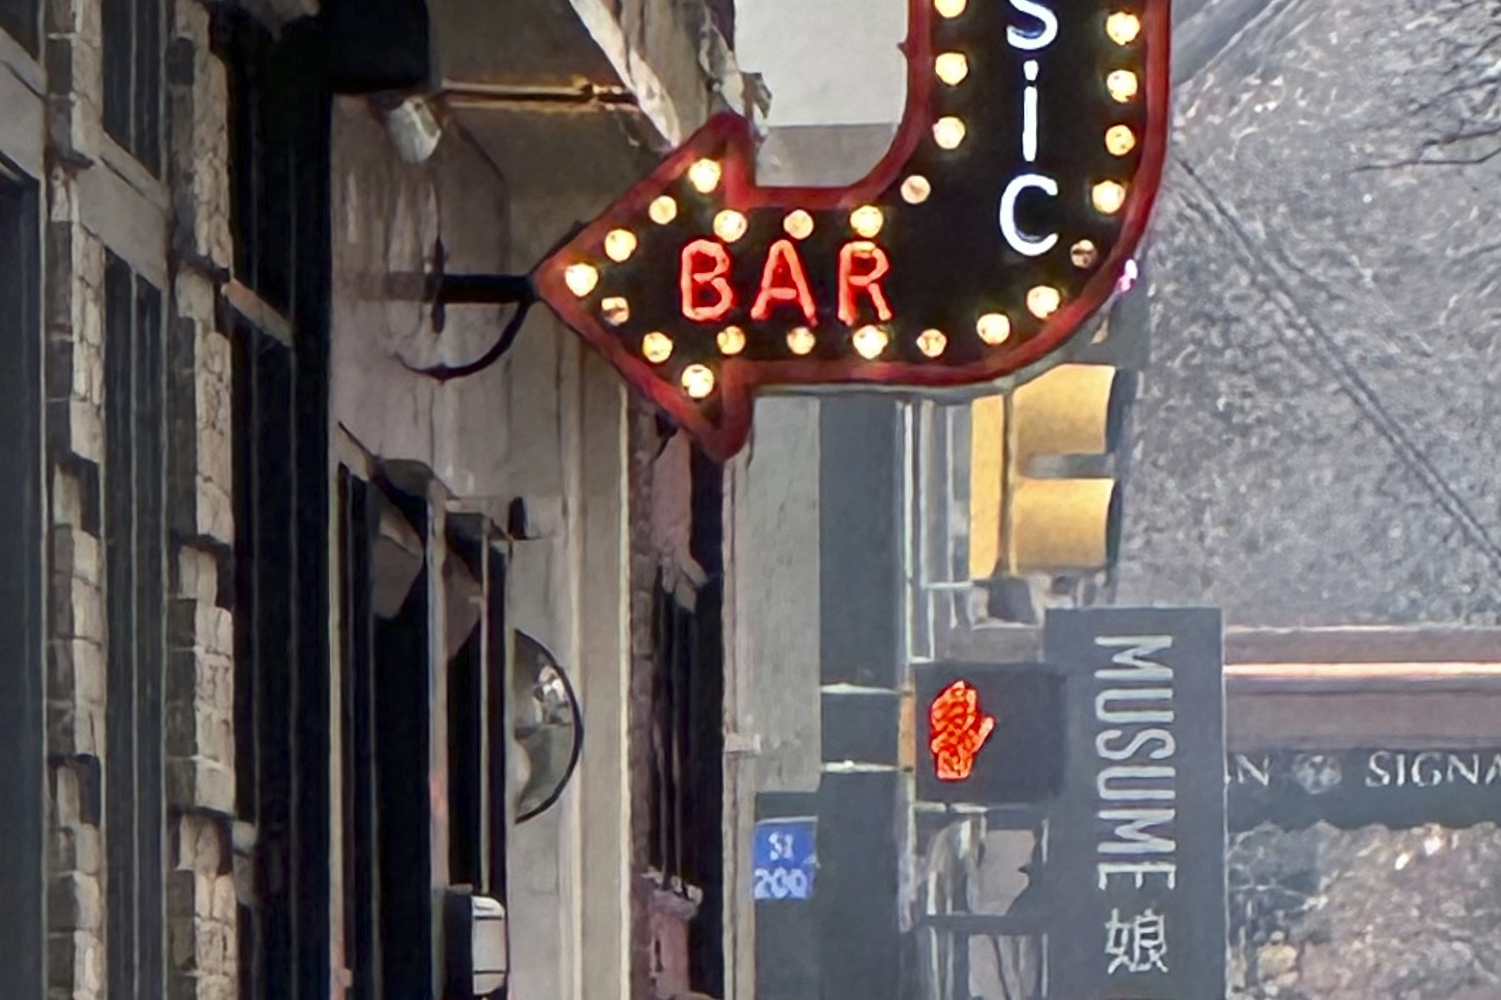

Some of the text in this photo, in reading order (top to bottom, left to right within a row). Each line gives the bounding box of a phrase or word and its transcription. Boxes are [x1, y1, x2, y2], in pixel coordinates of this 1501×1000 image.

[679, 239, 892, 326] BAR
[1094, 635, 1176, 891] MUSUME
[1104, 908, 1169, 974] 娘
